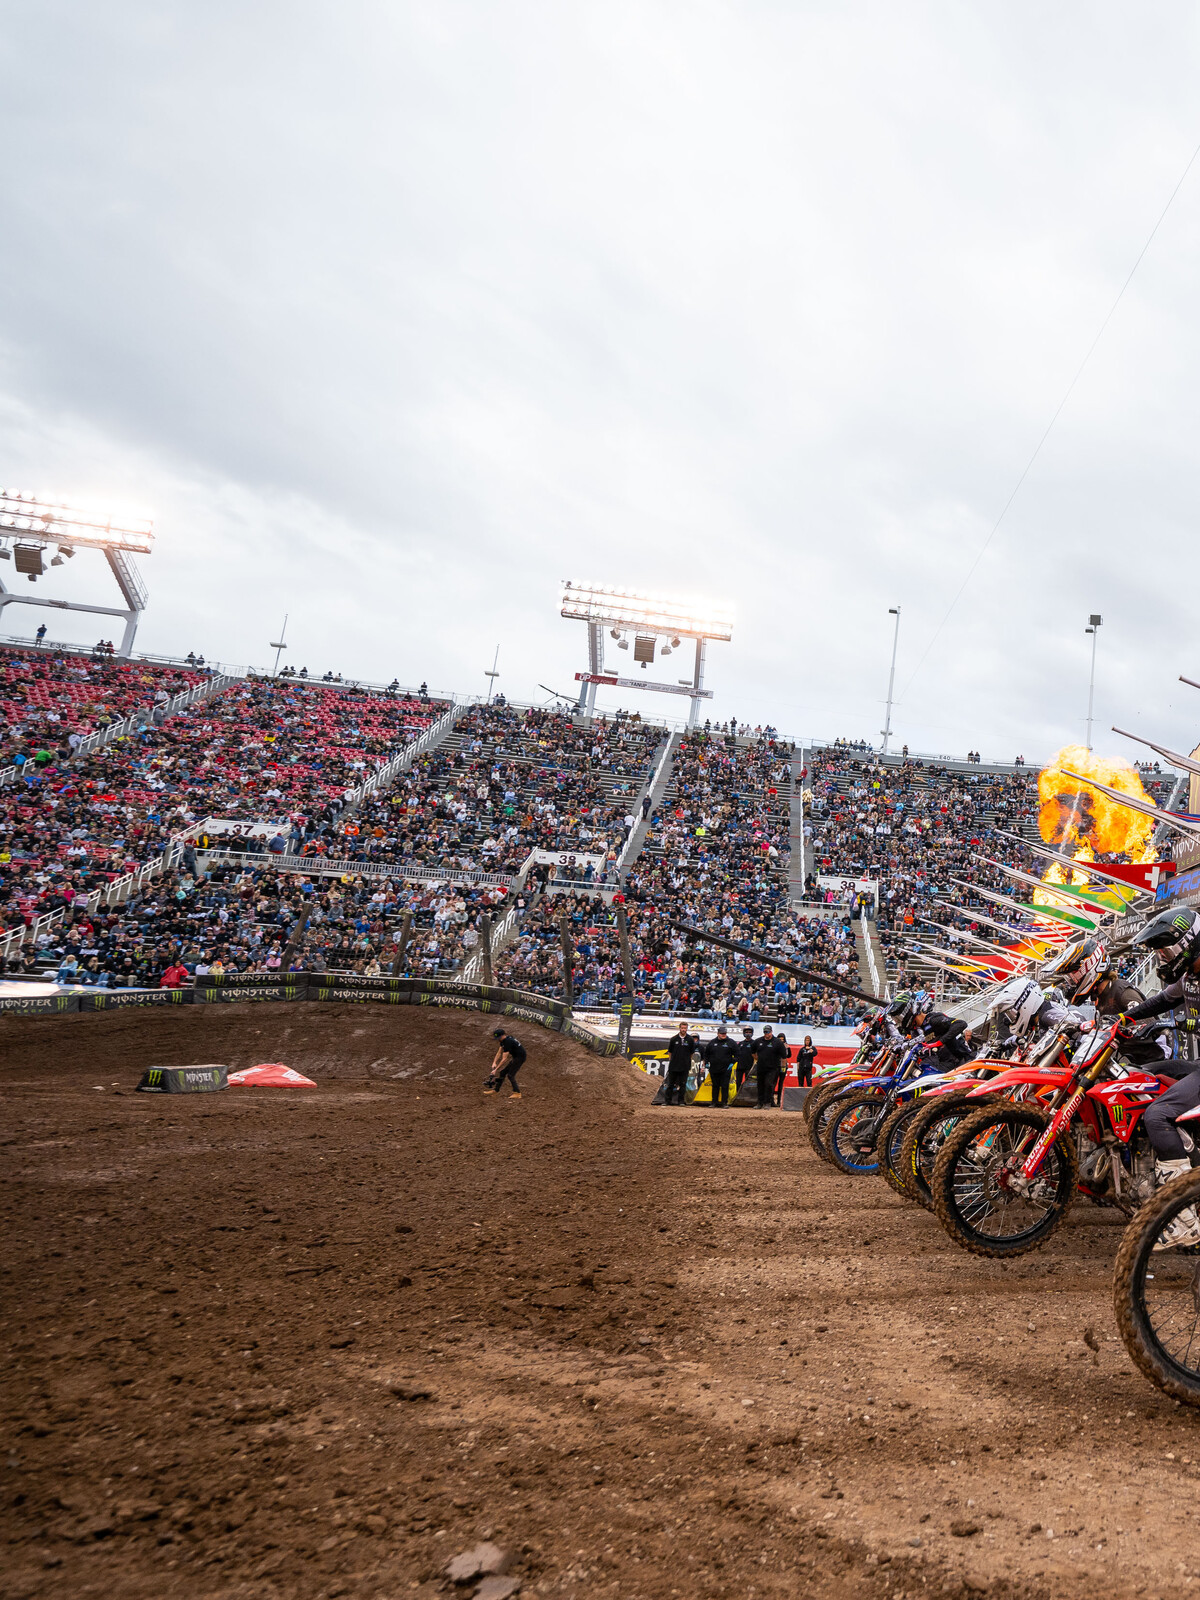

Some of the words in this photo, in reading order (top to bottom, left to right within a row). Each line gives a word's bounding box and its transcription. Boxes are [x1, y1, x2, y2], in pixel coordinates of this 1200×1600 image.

[232, 824, 254, 836] 37
[230, 974, 282, 982] MONSTER
[338, 977, 386, 987] MONSTER
[222, 987, 280, 998] MONSTER
[438, 981, 479, 993] MONSTER
[111, 993, 167, 1005] MONSTER
[333, 990, 386, 1000] MONSTER
[433, 995, 479, 1008] MONSTER
[513, 1007, 545, 1022] MONSTER
[186, 1072, 214, 1083] MONSTER
[1101, 1082, 1159, 1094] CRF
[1059, 1095, 1082, 1132] SHOWA
[1024, 1121, 1054, 1168] DUNLOP
